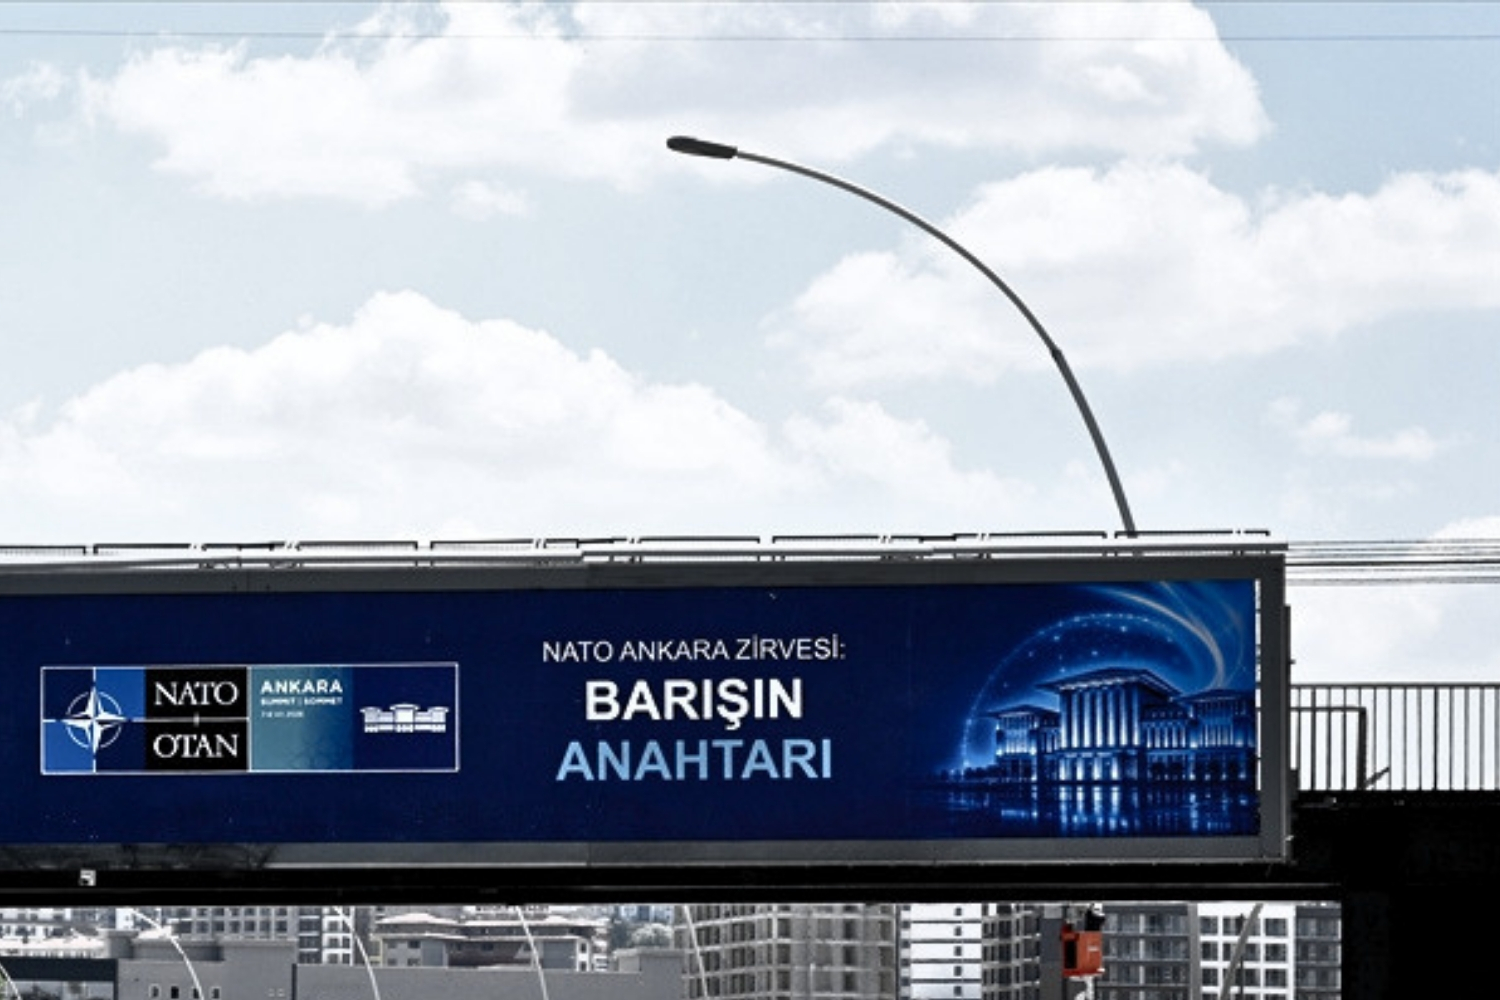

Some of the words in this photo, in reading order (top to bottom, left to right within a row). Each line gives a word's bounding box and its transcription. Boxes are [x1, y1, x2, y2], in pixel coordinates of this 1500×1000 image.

[542, 640, 613, 662] NATO
[619, 639, 730, 661] ANKARA
[735, 633, 845, 660] ZİRVESİ:
[154, 681, 239, 706] NATO
[260, 679, 343, 694] ANKARA
[586, 678, 802, 731] BARIŞIN
[153, 733, 239, 759] OTAN
[555, 738, 832, 781] ANAHTARI
